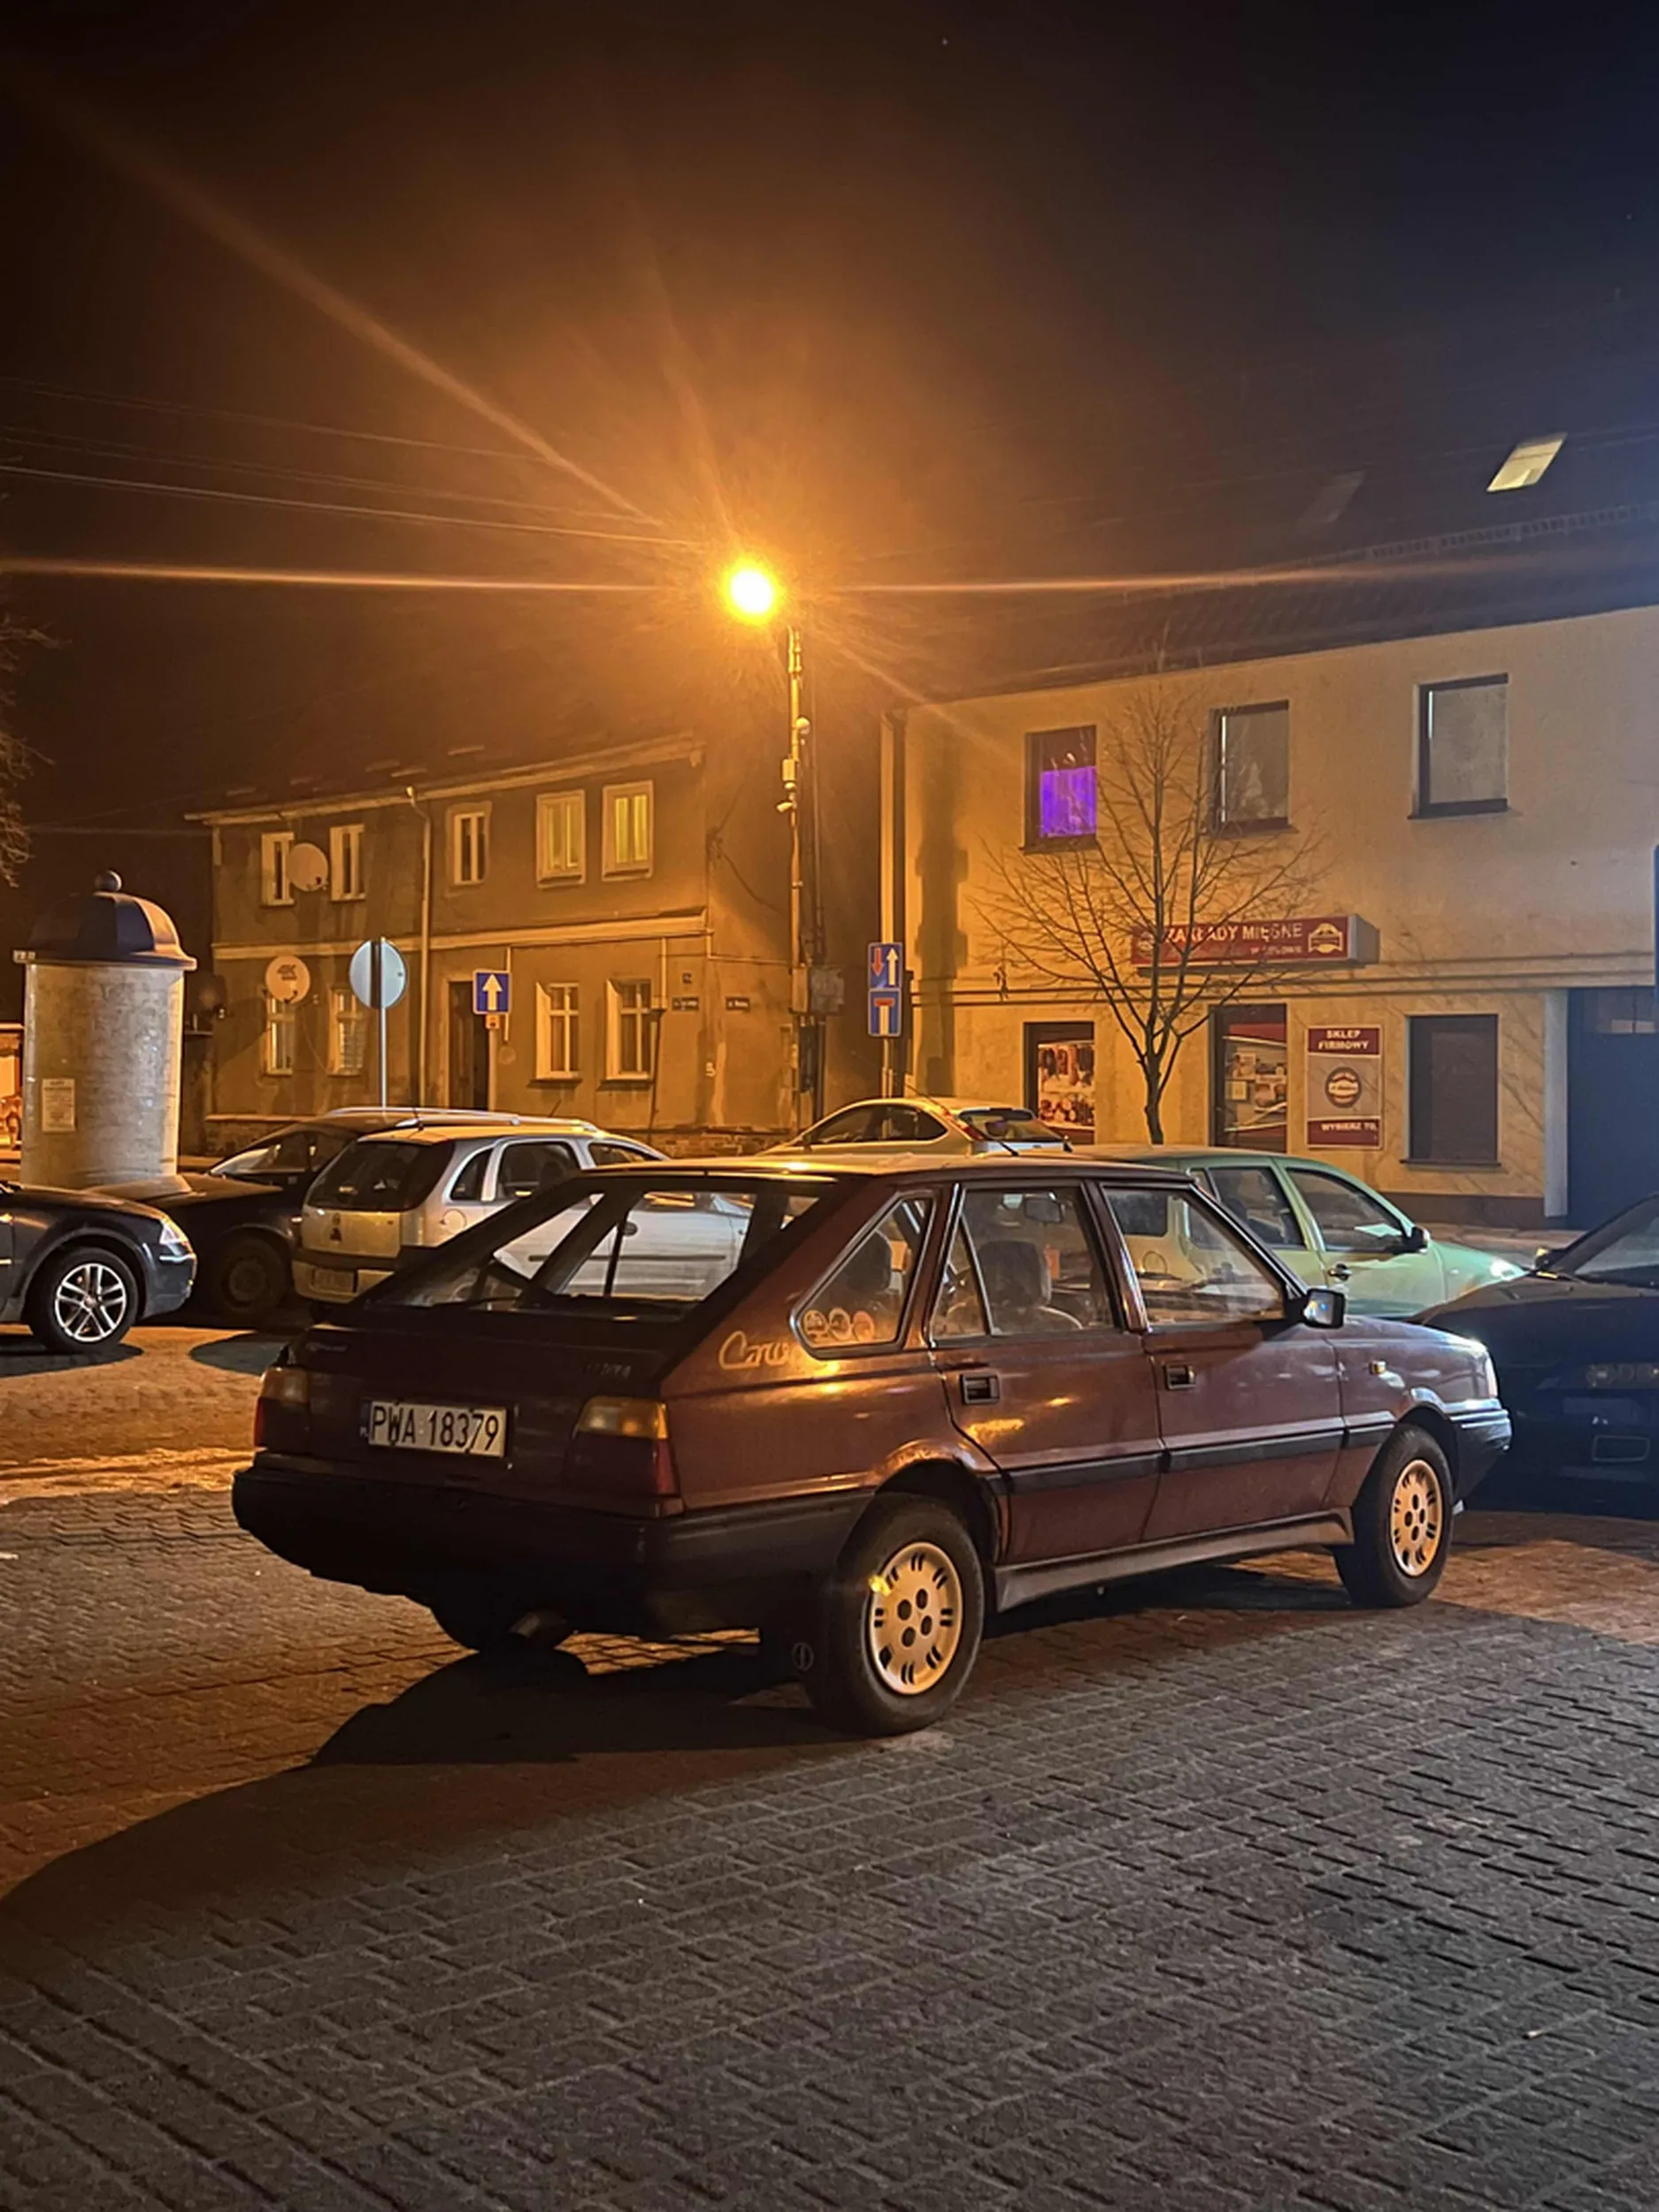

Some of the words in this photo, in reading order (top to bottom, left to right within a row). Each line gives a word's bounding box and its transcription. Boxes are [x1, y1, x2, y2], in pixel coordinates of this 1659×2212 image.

[1242, 923, 1303, 943] MIĘSNE
[1326, 1029, 1361, 1039] SKLEP
[1318, 1040, 1369, 1050] FIRMOWY
[372, 1405, 417, 1446] PWA
[428, 1409, 499, 1451] 18379
